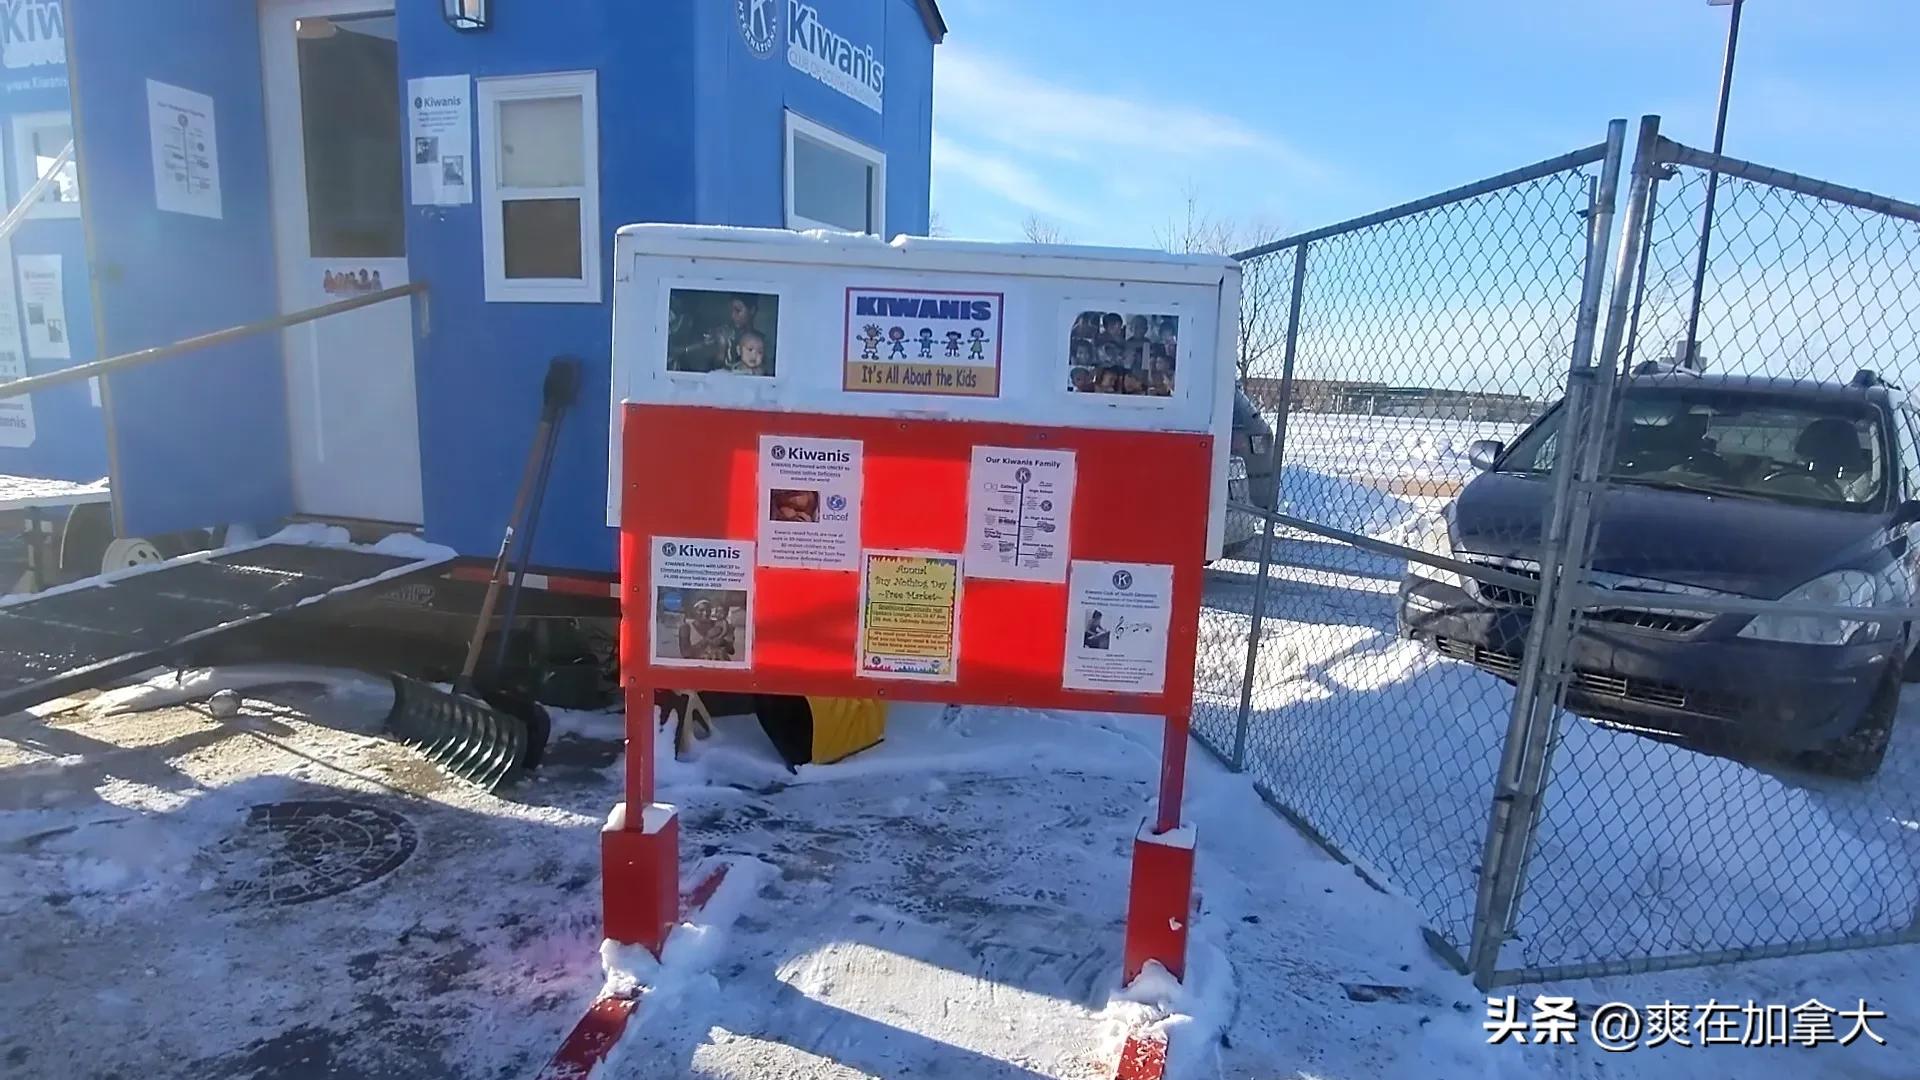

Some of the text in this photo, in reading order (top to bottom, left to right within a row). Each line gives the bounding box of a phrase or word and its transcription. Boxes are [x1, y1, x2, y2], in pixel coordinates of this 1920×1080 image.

[788, 0, 884, 94] Kiwanis
[424, 96, 461, 107] Kiwanis
[856, 296, 992, 321] KIWANIS
[862, 365, 976, 388] It's All About the Kids
[788, 447, 850, 462] Kiwanis
[986, 456, 1061, 468] Our Kiwanis Family
[823, 512, 848, 521] unicef
[679, 544, 740, 559] Kiwanis
[895, 565, 927, 575] Annual
[893, 577, 929, 589] Nothing
[931, 580, 948, 590] Day
